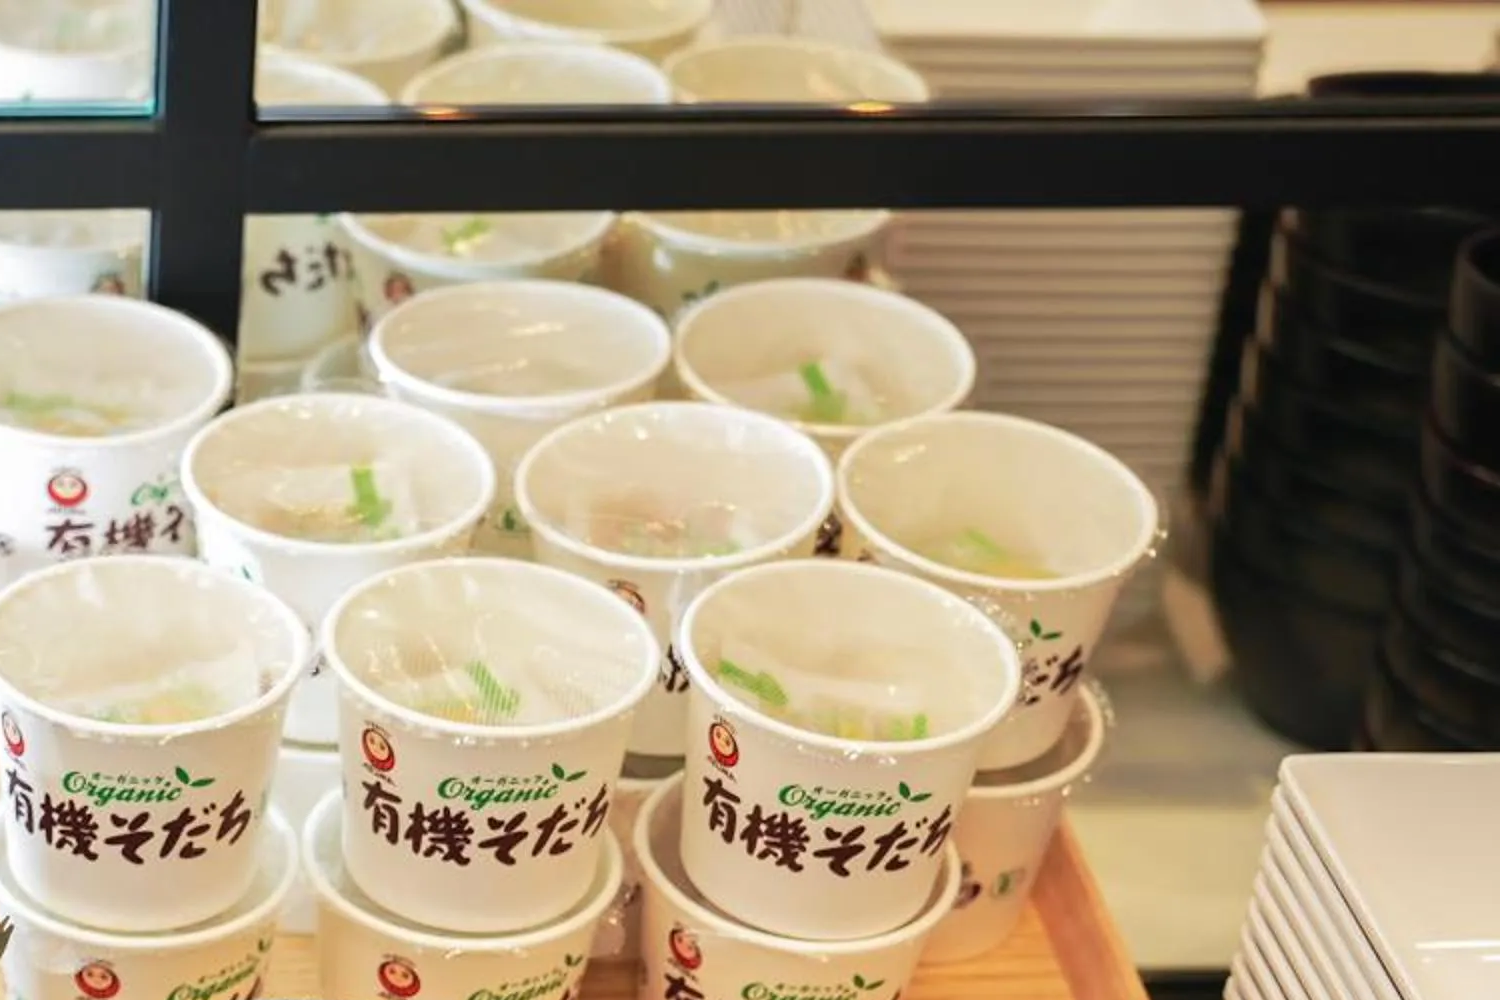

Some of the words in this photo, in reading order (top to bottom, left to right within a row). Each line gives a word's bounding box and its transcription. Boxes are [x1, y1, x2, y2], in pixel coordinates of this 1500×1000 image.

[5, 768, 251, 865] 有機そだち
[63, 771, 183, 806] Organic
[438, 777, 558, 810] Organic
[779, 784, 901, 820] Organic
[362, 781, 610, 866] 有機そだち
[703, 776, 952, 877] 有機そだち
